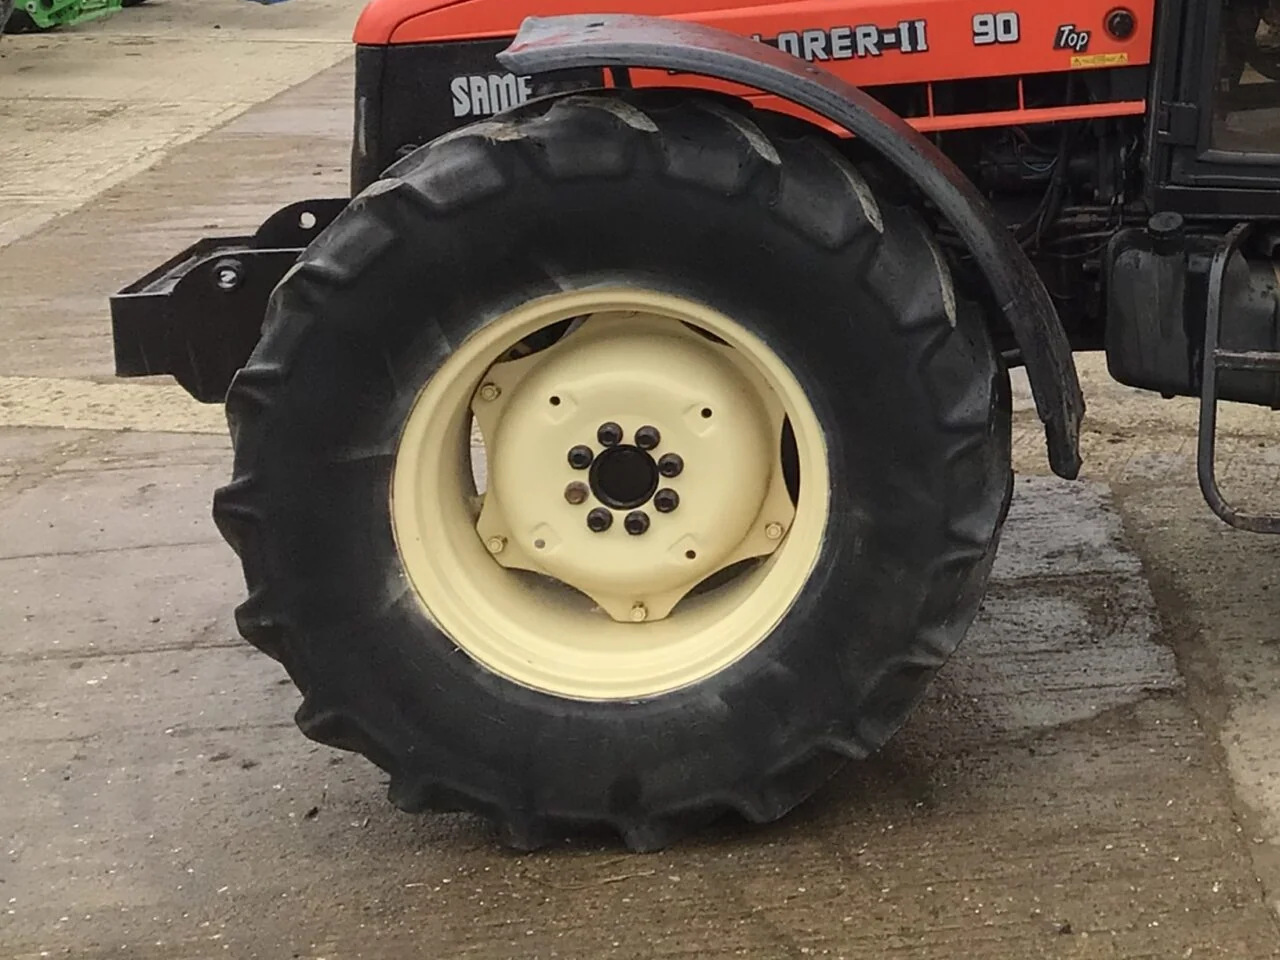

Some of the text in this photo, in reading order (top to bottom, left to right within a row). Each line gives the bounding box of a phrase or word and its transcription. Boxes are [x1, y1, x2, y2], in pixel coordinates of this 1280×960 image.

[753, 11, 1020, 61] ORER-II 90
[1060, 25, 1089, 51] Top
[450, 72, 532, 117] SAME
